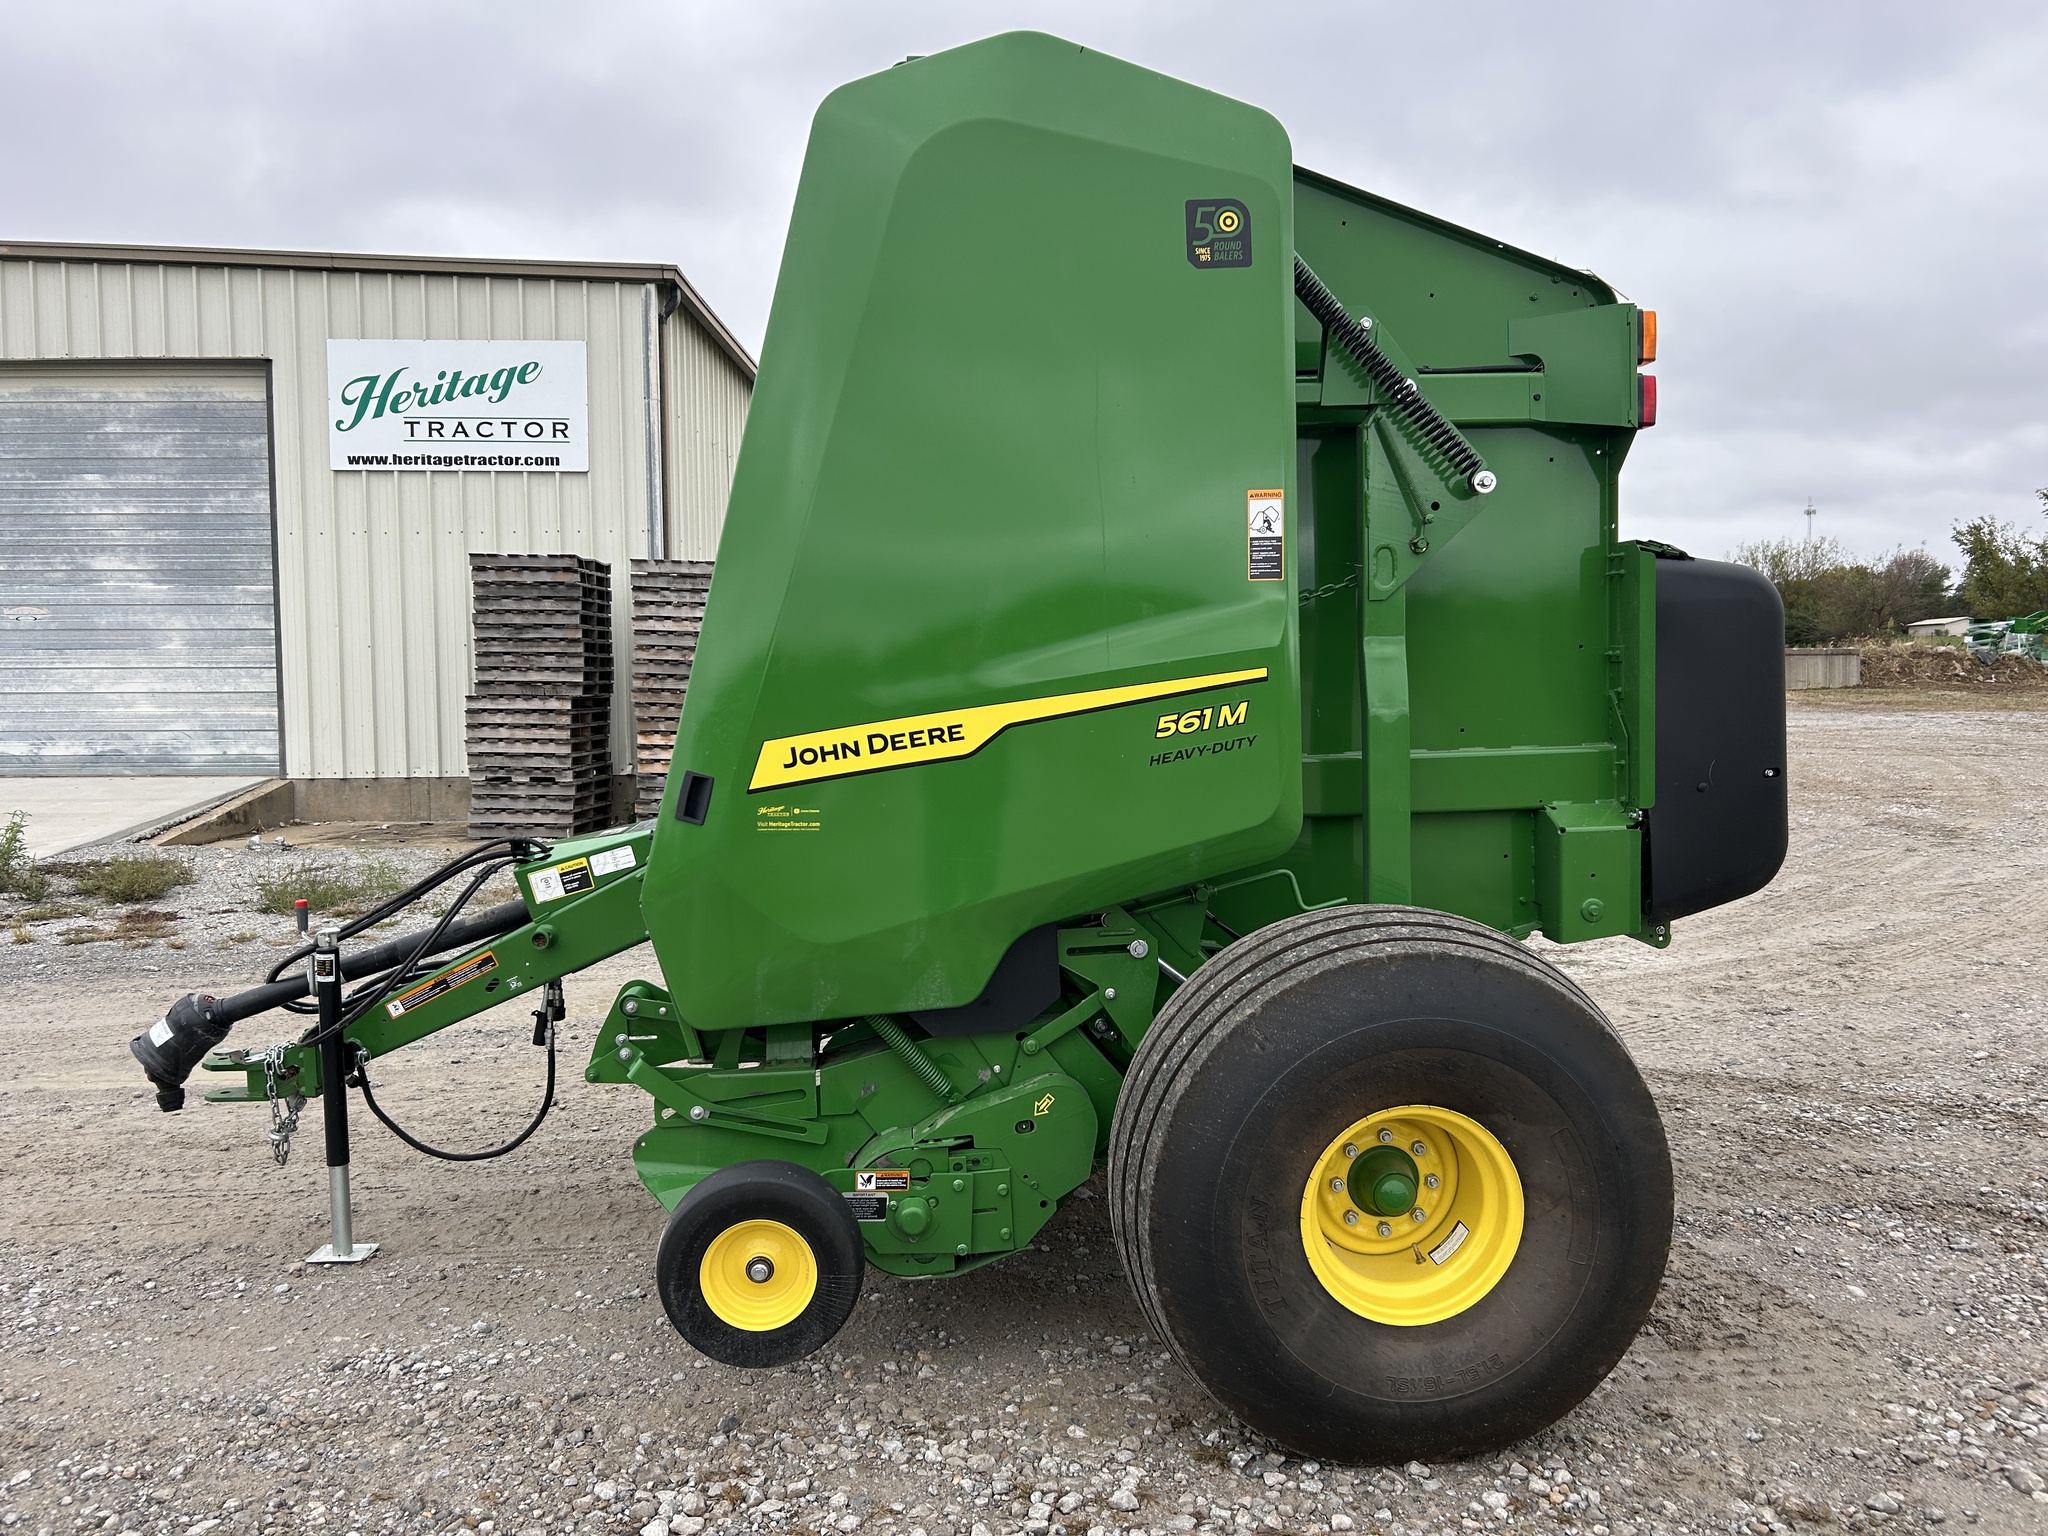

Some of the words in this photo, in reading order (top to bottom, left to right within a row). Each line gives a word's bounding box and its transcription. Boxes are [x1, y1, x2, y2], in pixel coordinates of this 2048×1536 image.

[1194, 247, 1211, 255] SINCE
[1213, 241, 1242, 251] ROUND
[1199, 254, 1211, 262] 1975
[1214, 250, 1243, 261] BALERS
[335, 360, 543, 432] Heritage
[403, 420, 570, 439] TRACTOR
[347, 453, 561, 467] www.heritagetractor.com
[1153, 705, 1214, 740] 561
[1216, 699, 1251, 728] M
[782, 740, 861, 769] JOHN
[868, 723, 965, 755] DEERE
[1148, 733, 1259, 767] HEAVY-DUTY
[757, 805, 785, 816] Heritage
[564, 860, 584, 870] CAUTION
[1248, 1194, 1289, 1318] TITAN
